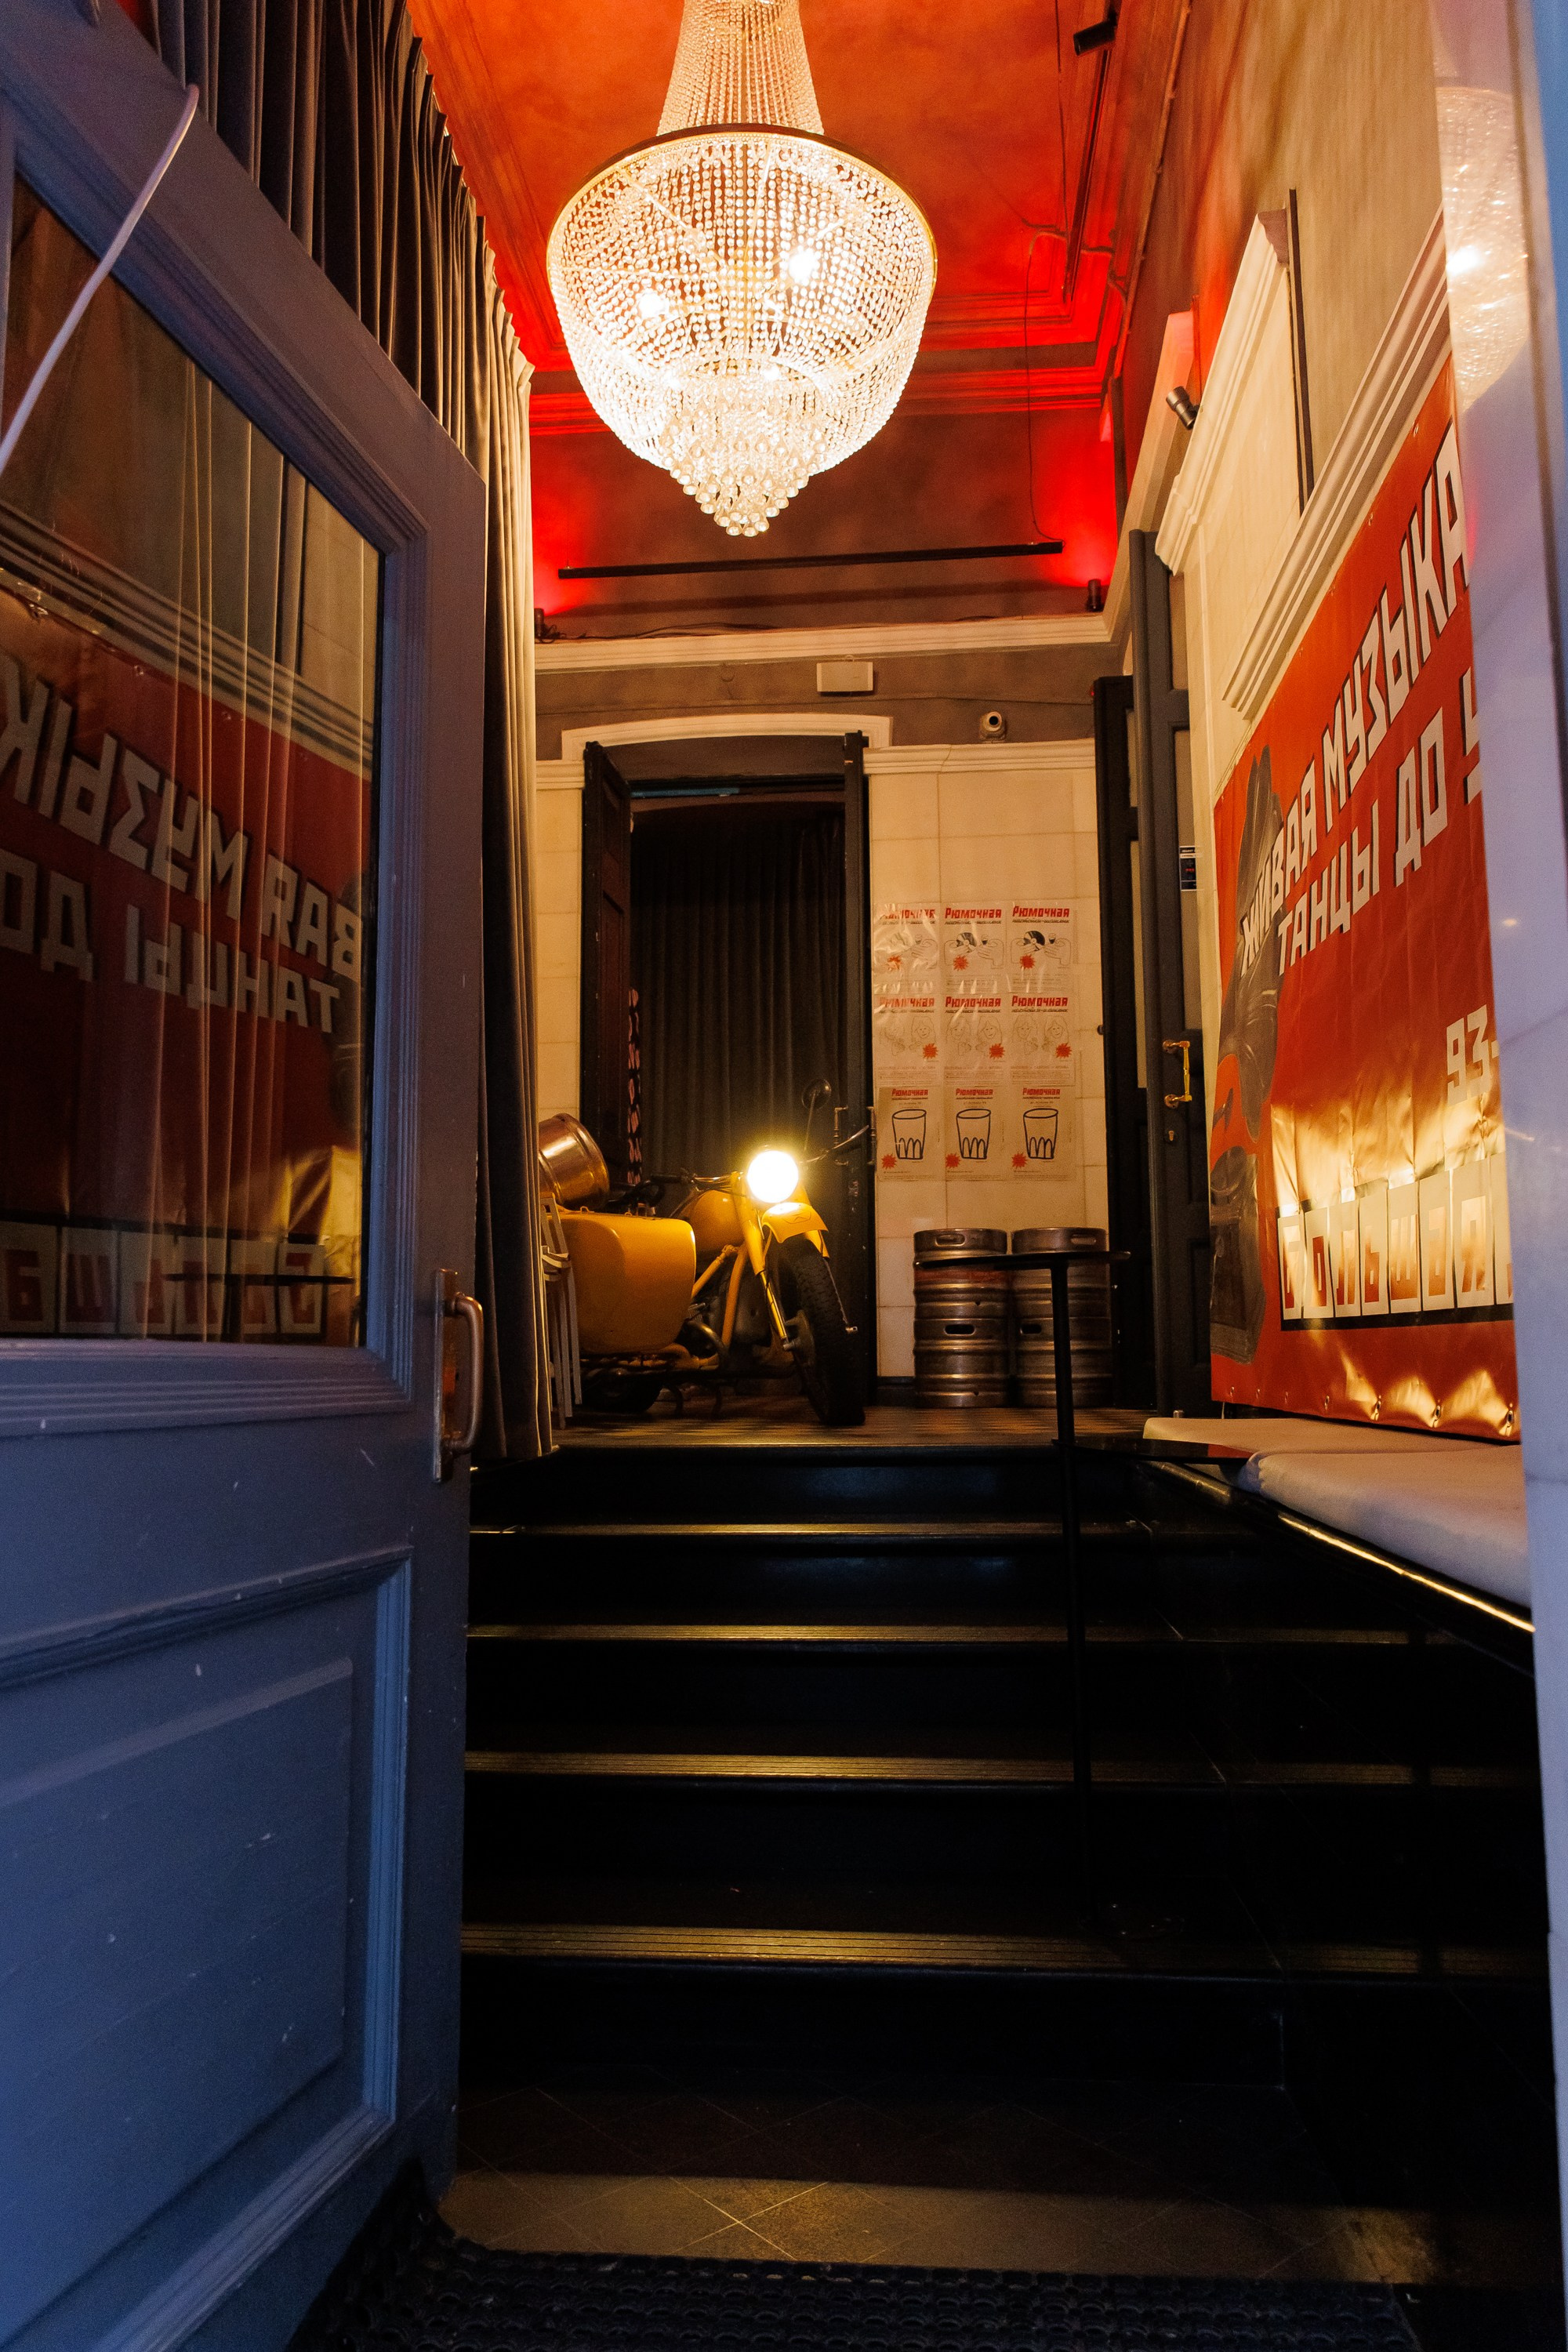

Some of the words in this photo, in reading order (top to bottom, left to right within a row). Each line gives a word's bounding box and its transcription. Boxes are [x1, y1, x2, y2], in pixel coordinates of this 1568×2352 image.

[1241, 762, 1317, 977] ЖИВАЯ
[1324, 423, 1468, 832] МУЗЫКА
[1278, 801, 1379, 976] ТАНЦЫ
[1395, 708, 1447, 887] ДО
[945, 907, 1002, 919] Рюмочная
[1012, 906, 1069, 917] Рюмочная
[1011, 995, 1069, 1007] Рюмочная
